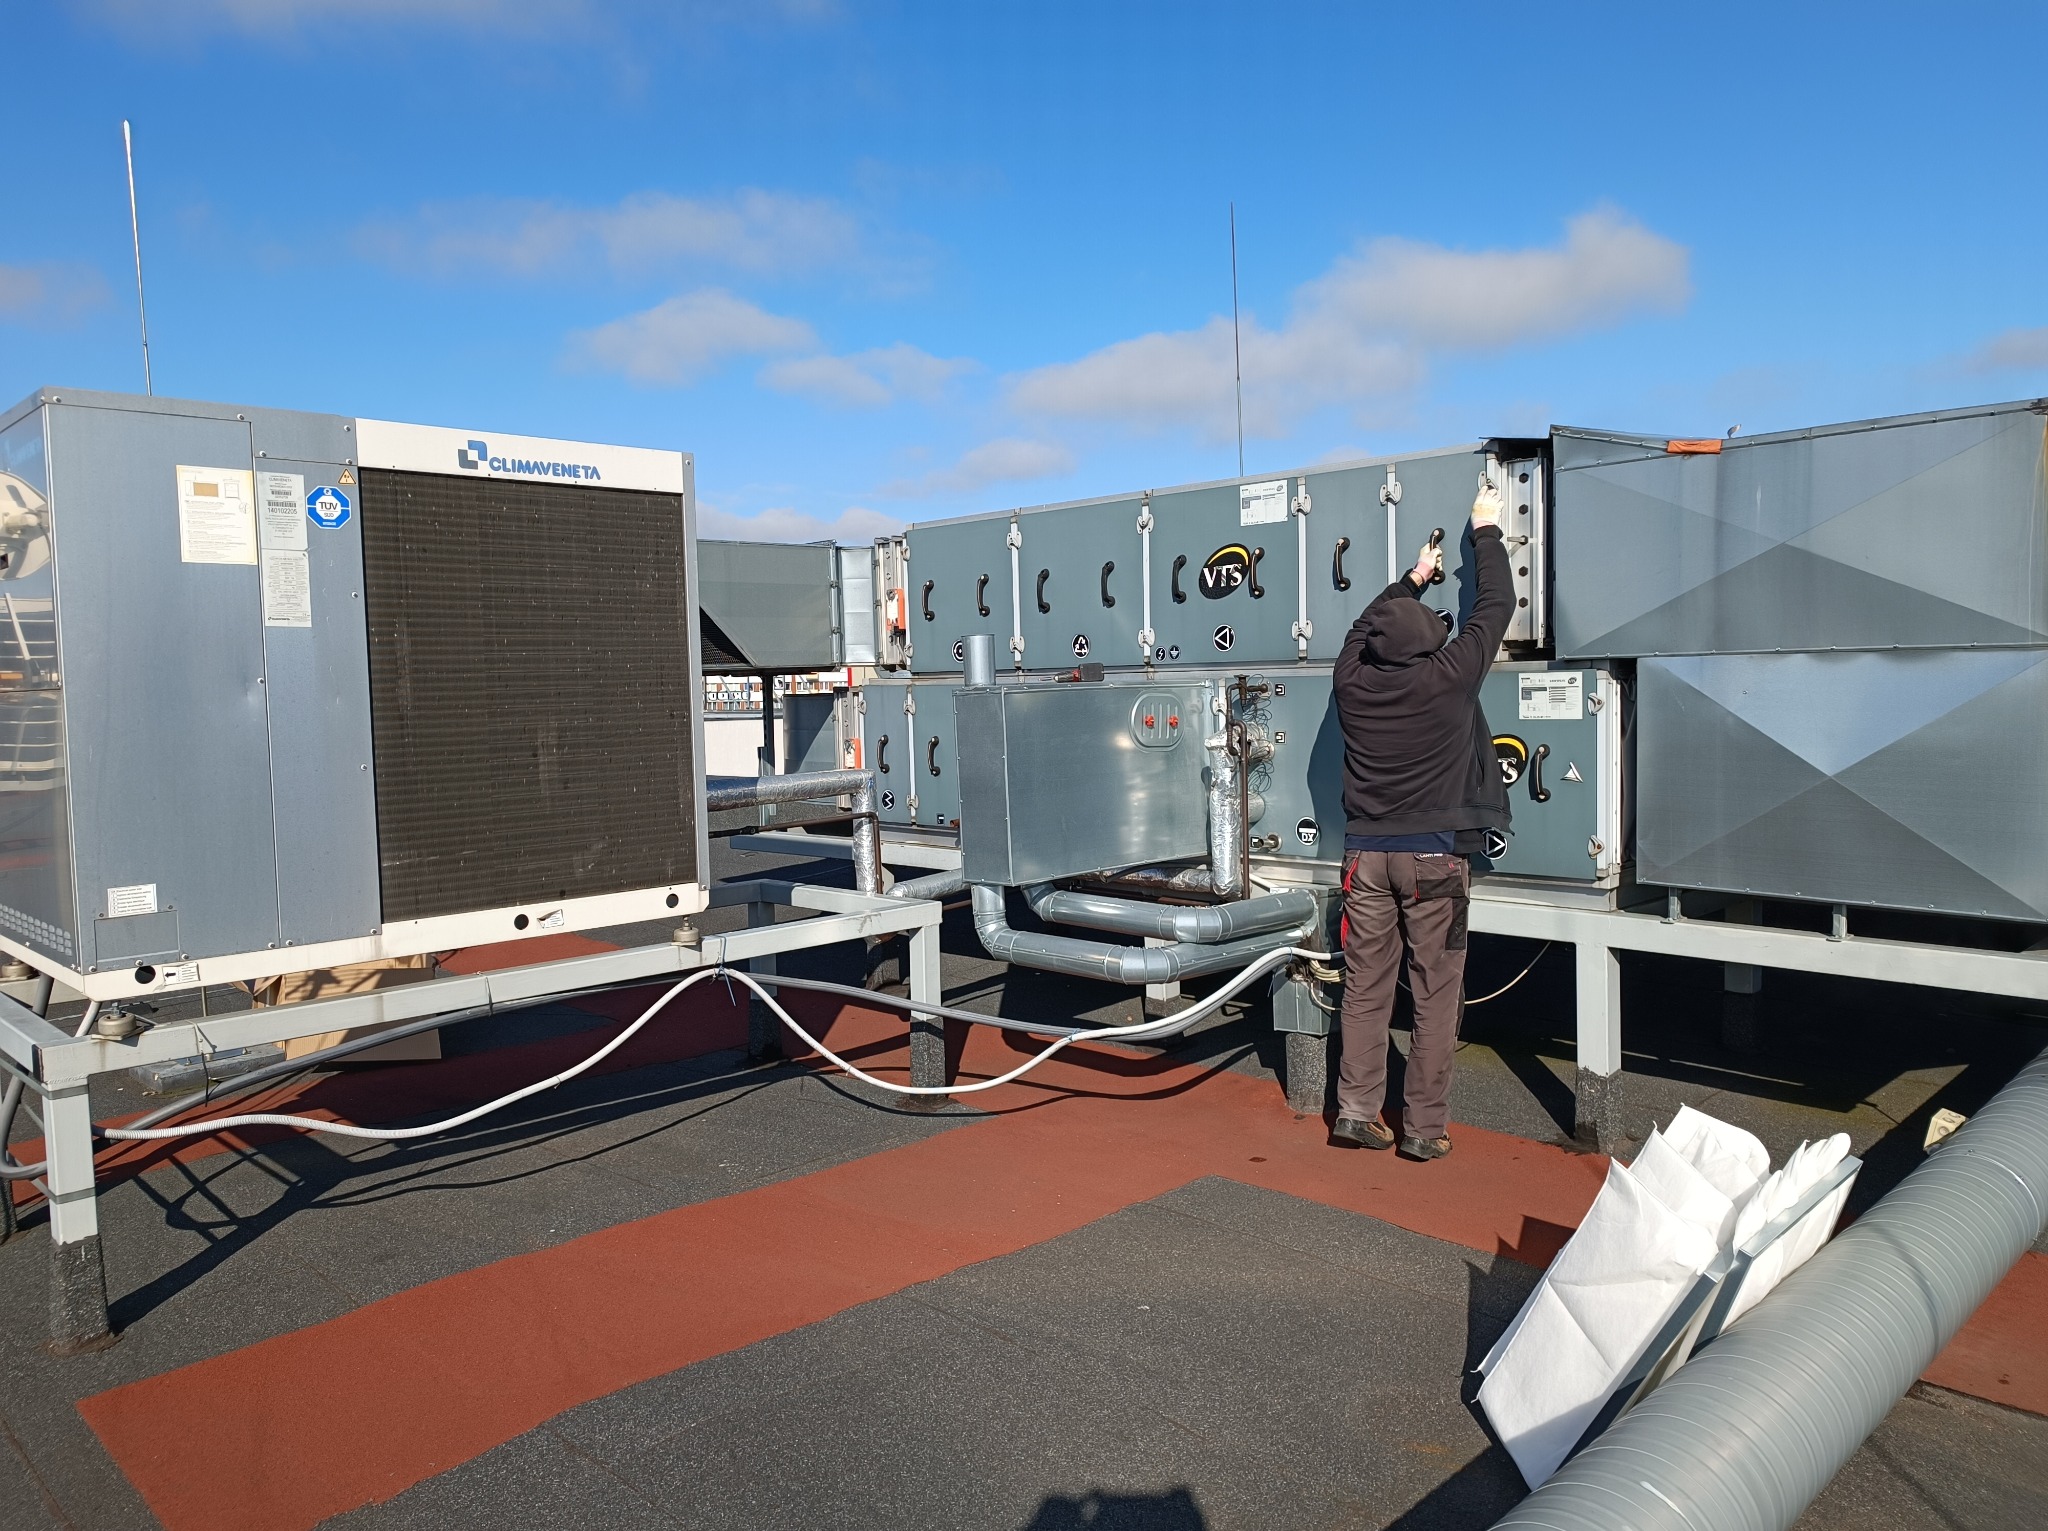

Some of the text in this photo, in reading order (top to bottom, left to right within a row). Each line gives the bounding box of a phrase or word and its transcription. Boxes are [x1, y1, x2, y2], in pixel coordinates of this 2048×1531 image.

[489, 456, 601, 480] CLIMAVENETA
[318, 501, 338, 511] TÜV
[1202, 563, 1243, 588] VTS
[1301, 832, 1315, 842] DX
